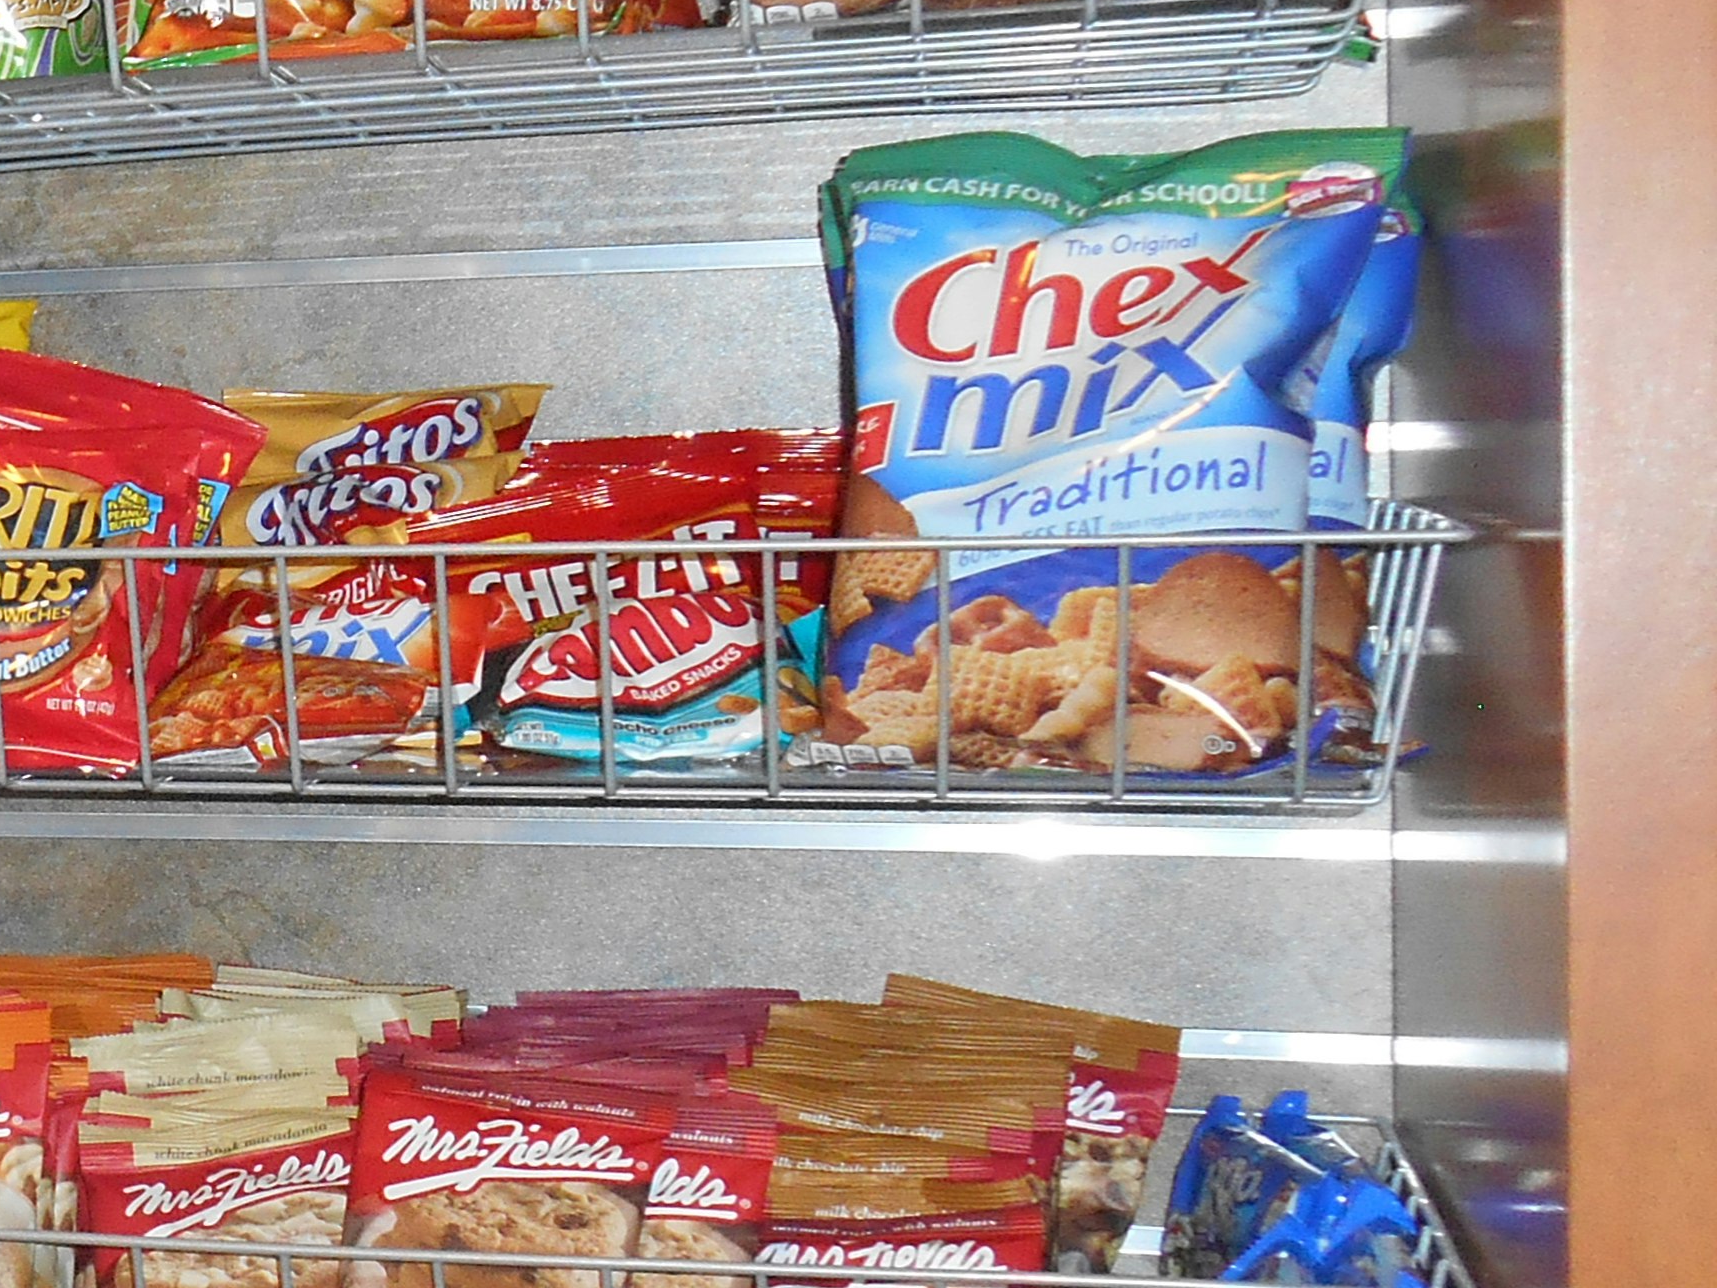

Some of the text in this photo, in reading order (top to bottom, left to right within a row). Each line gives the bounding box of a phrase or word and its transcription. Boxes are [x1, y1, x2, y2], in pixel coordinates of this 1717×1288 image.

[925, 177, 1267, 209] CASH FOR SCHOOL!
[1065, 231, 1200, 257] The Original
[892, 224, 1273, 367] Chex
[911, 292, 1245, 457] mix
[245, 472, 441, 546] Fritos
[962, 440, 1268, 533] Traditional
[468, 519, 743, 623] CHEEZ-IT
[16, 637, 72, 679] Butter
[629, 647, 742, 703] BAKED SNACKS
[611, 716, 737, 736] acho cheese
[486, 1090, 532, 1109] raisin
[535, 1099, 569, 1113] with
[571, 1101, 636, 1119] walnuts
[154, 1120, 328, 1160] white macadamia
[381, 1114, 635, 1171] Mrs. Fields
[668, 1129, 734, 1146] walnuts
[123, 1149, 351, 1216] Mrs. Fields
[794, 1158, 906, 1177] chocolate chip
